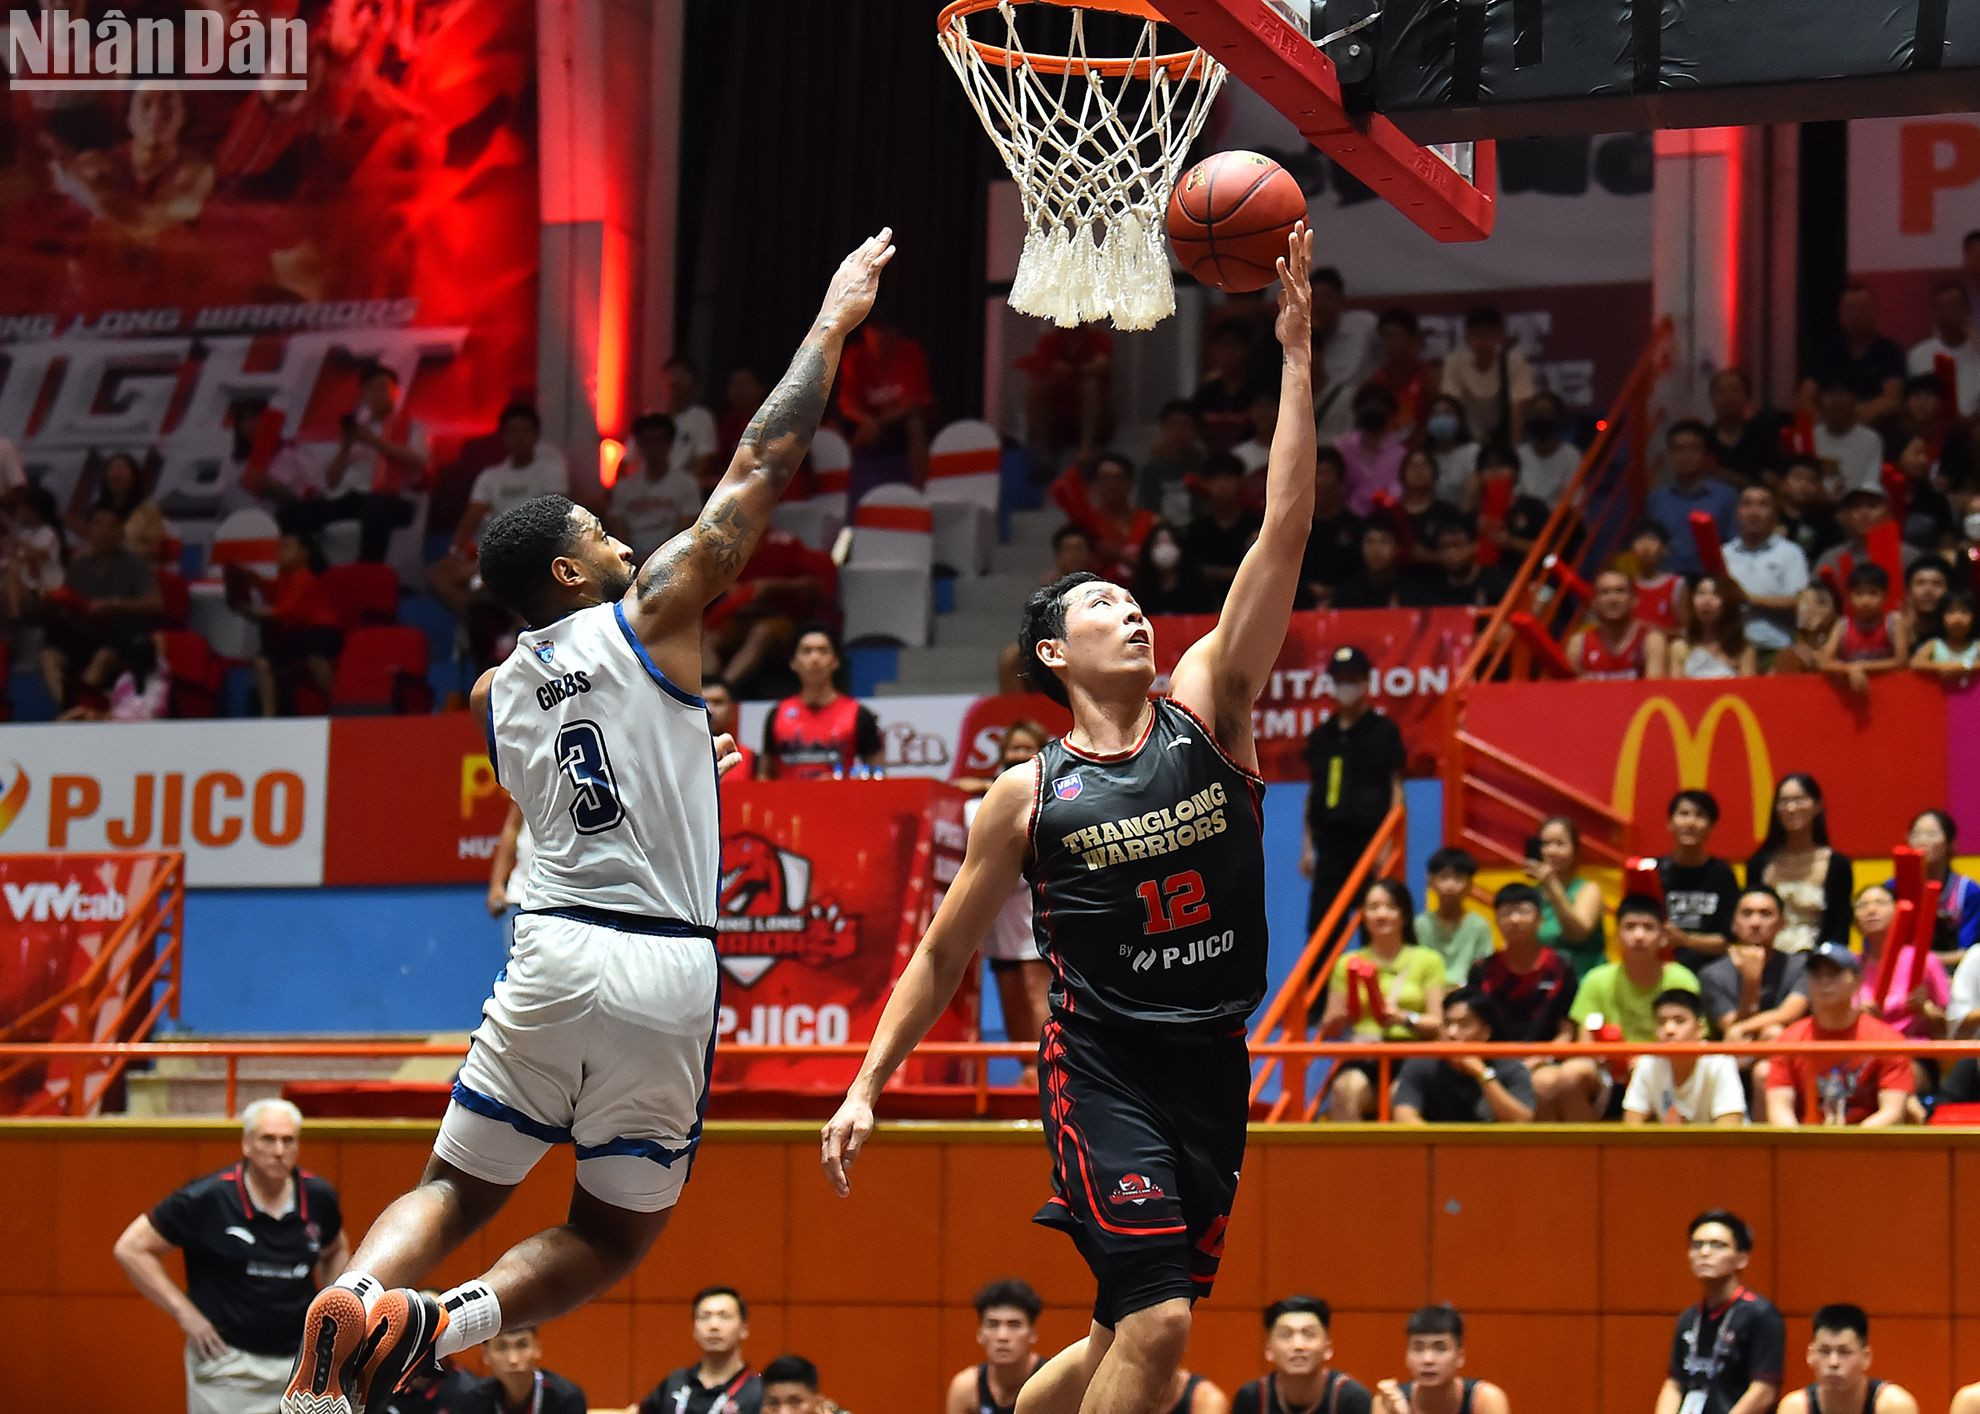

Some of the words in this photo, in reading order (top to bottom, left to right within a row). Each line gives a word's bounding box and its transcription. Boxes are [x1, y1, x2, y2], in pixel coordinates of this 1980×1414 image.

[536, 670, 592, 711] GIBBS
[554, 719, 626, 836] 3
[1056, 776, 1079, 791] VBA
[48, 770, 306, 848] PJICO
[1082, 809, 1227, 871] WARRIORS
[1136, 869, 1211, 935] 12
[1120, 944, 1133, 957] By
[1162, 930, 1234, 969] PJICO
[719, 1004, 849, 1046] PJICO
